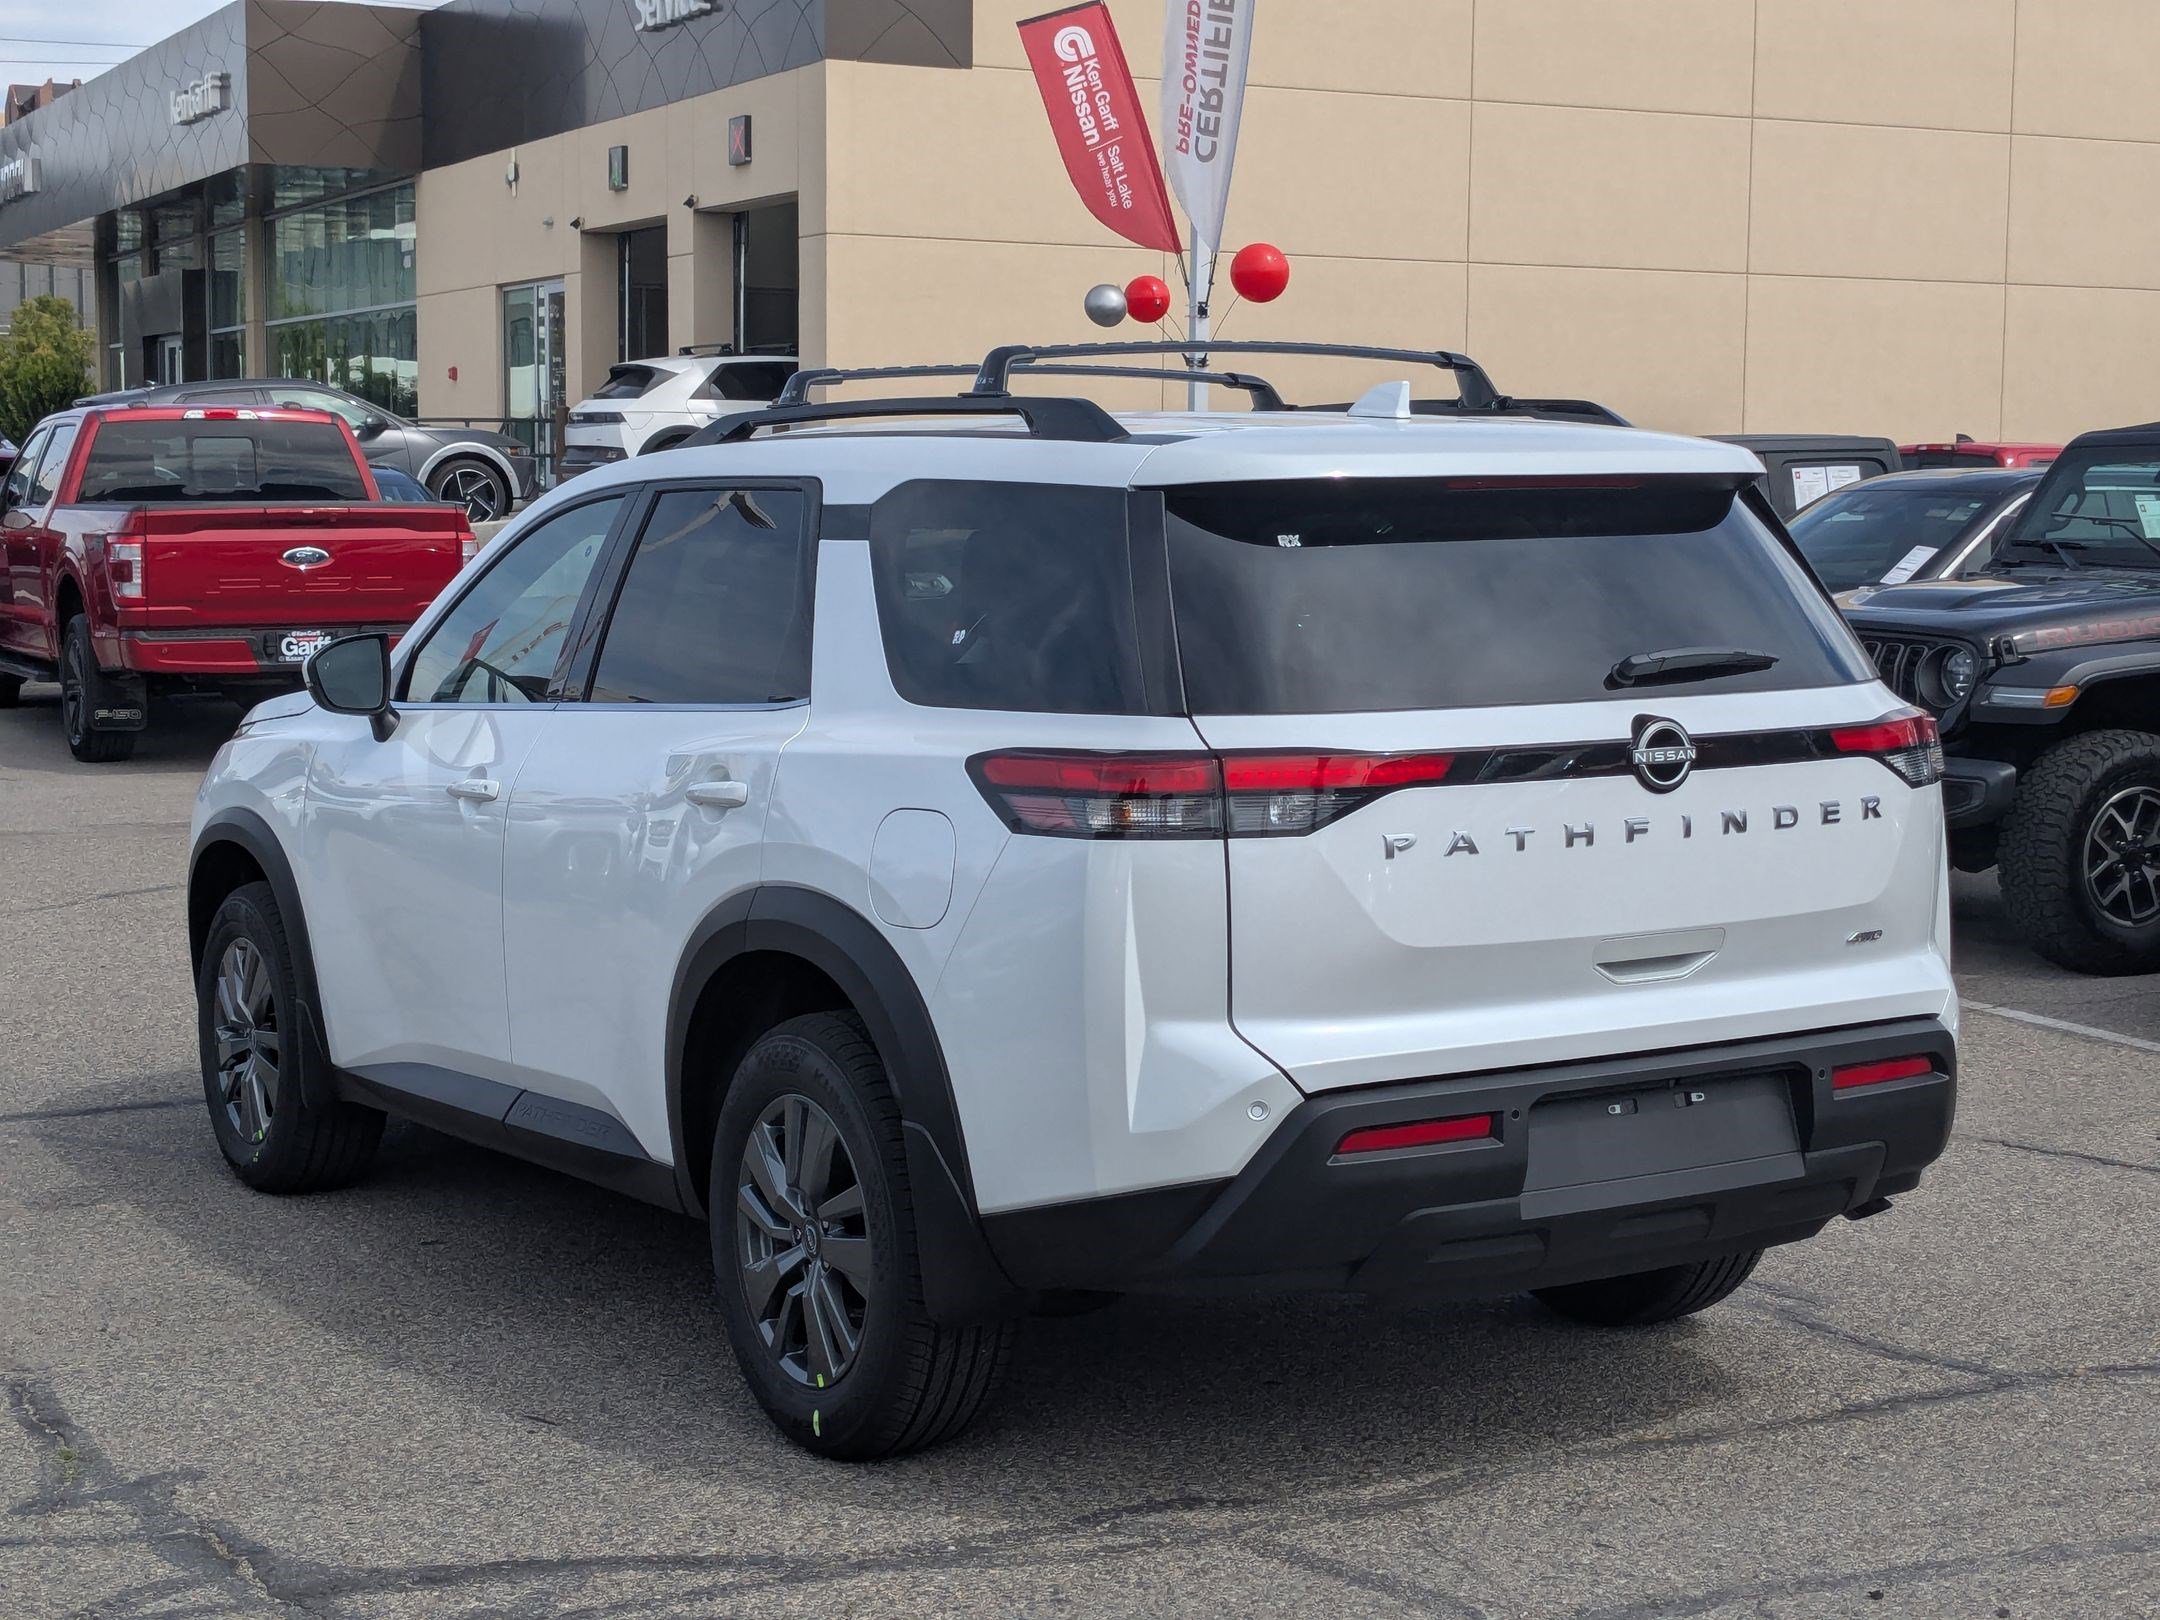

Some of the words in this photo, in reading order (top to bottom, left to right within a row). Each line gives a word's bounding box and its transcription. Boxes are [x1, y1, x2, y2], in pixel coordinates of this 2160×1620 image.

[1062, 64, 1100, 146] Nissan
[1083, 57, 1103, 92] Ken
[1095, 90, 1119, 131] Garff
[1096, 151, 1106, 167] we
[1100, 166, 1113, 189] hear
[1107, 144, 1124, 174] Salt
[1116, 173, 1133, 209] Lake
[1106, 187, 1118, 208] you
[94, 708, 142, 720] F-150
[1634, 748, 1697, 763] NISSAN
[1382, 794, 1883, 860] PATHFINDER
